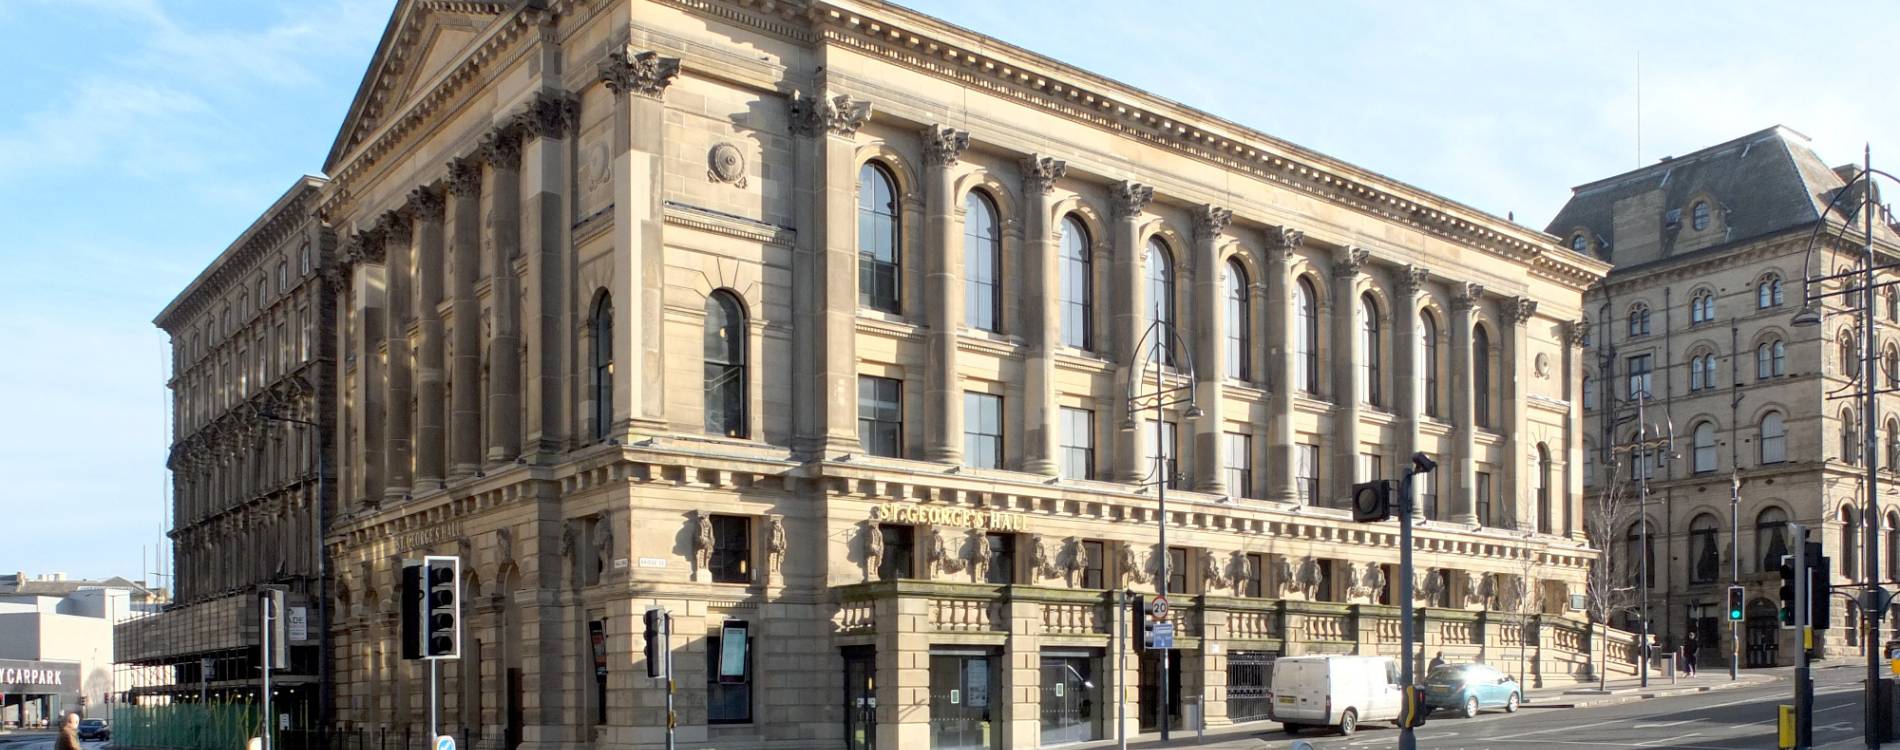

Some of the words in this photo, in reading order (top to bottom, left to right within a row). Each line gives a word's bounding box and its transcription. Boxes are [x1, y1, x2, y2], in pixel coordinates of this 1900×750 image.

[906, 504, 985, 528] GEORGE'S
[990, 511, 1028, 531] HALL
[1154, 603, 1166, 613] 20
